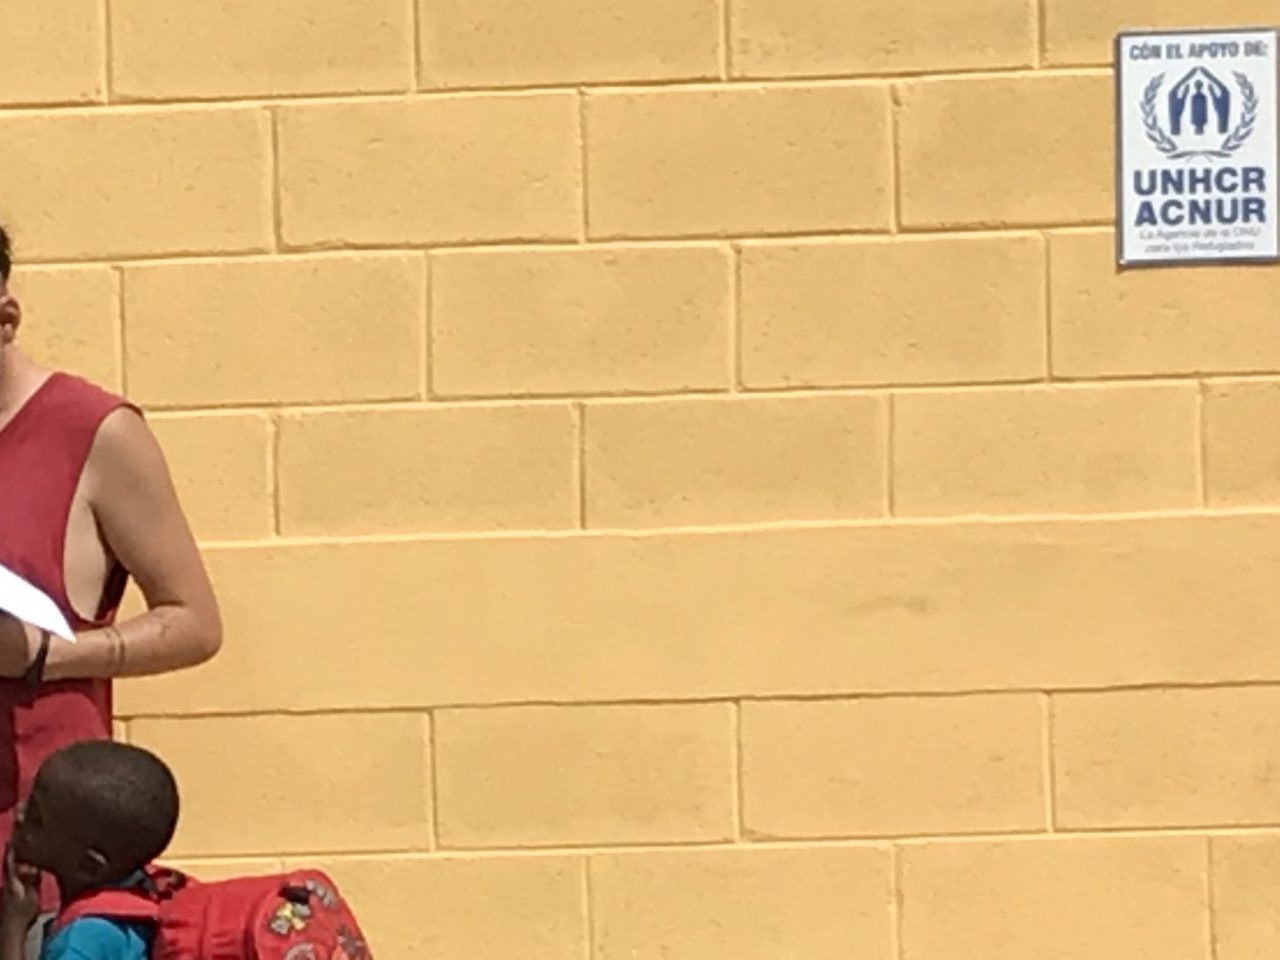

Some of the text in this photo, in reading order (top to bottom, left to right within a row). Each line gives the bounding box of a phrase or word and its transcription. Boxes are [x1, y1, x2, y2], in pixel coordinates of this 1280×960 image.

[1166, 43, 1183, 59] EL
[1187, 41, 1239, 59] APOYO
[1133, 167, 1266, 196] UNHCR
[1134, 197, 1266, 226] ACNUR
